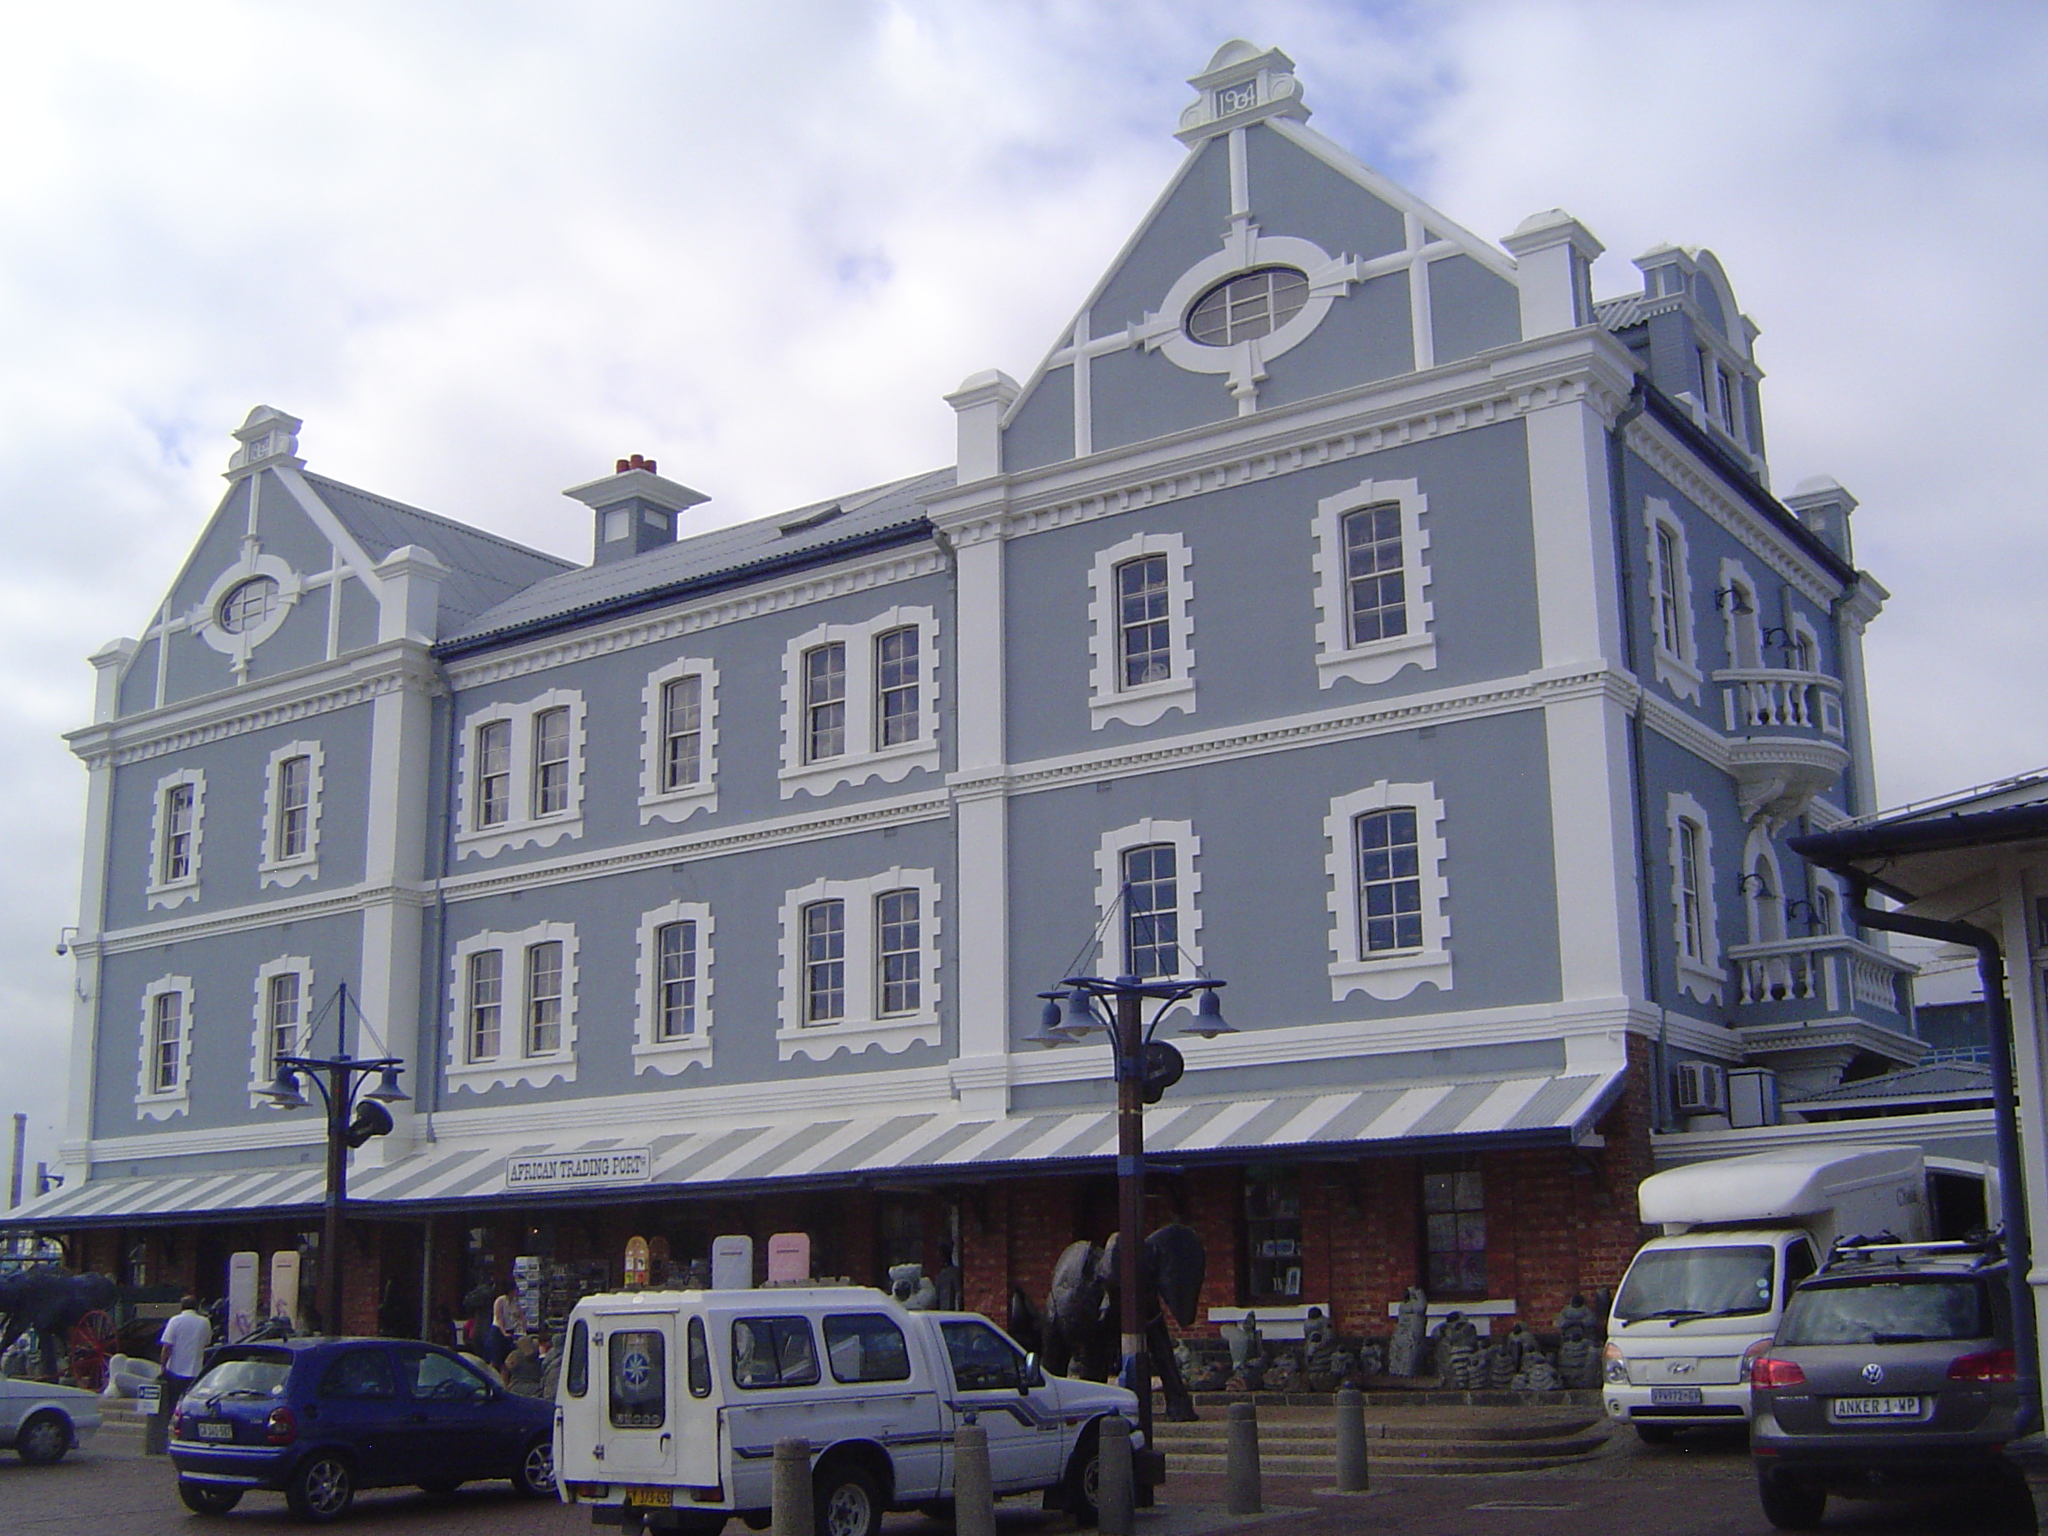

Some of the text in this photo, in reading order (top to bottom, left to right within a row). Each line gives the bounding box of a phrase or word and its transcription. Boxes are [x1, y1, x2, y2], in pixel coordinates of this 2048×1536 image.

[1220, 84, 1256, 116] 1904
[510, 1161, 557, 1182] AFRICAN
[560, 1158, 609, 1178] TRADING
[612, 1155, 642, 1175] PORT
[1838, 1398, 1916, 1414] ANKER 1 WP
